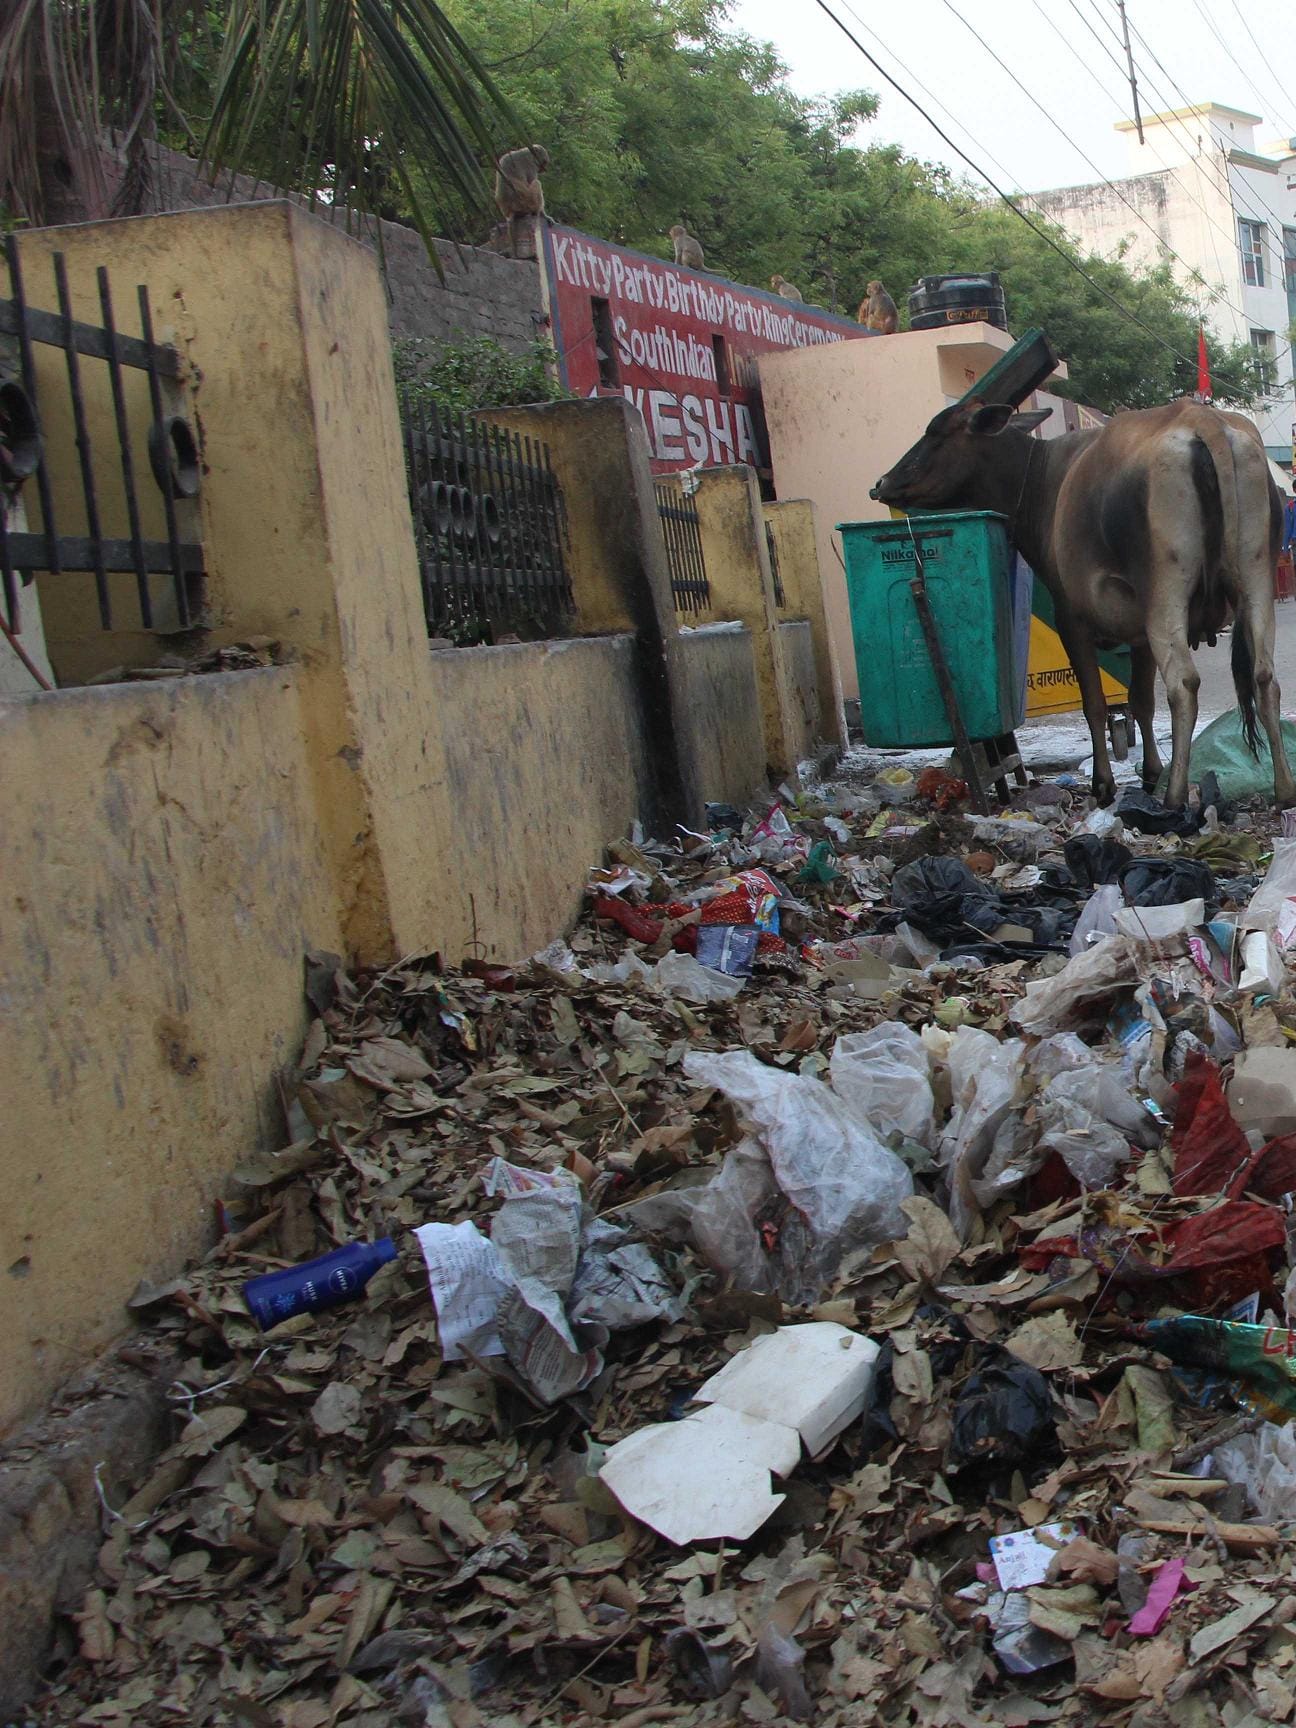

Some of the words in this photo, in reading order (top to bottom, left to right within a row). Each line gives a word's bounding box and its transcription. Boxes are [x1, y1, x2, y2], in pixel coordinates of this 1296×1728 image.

[551, 233, 611, 294] Kitty
[305, 1280, 318, 1302] MUSK
[336, 1269, 348, 1292] NIVEA
